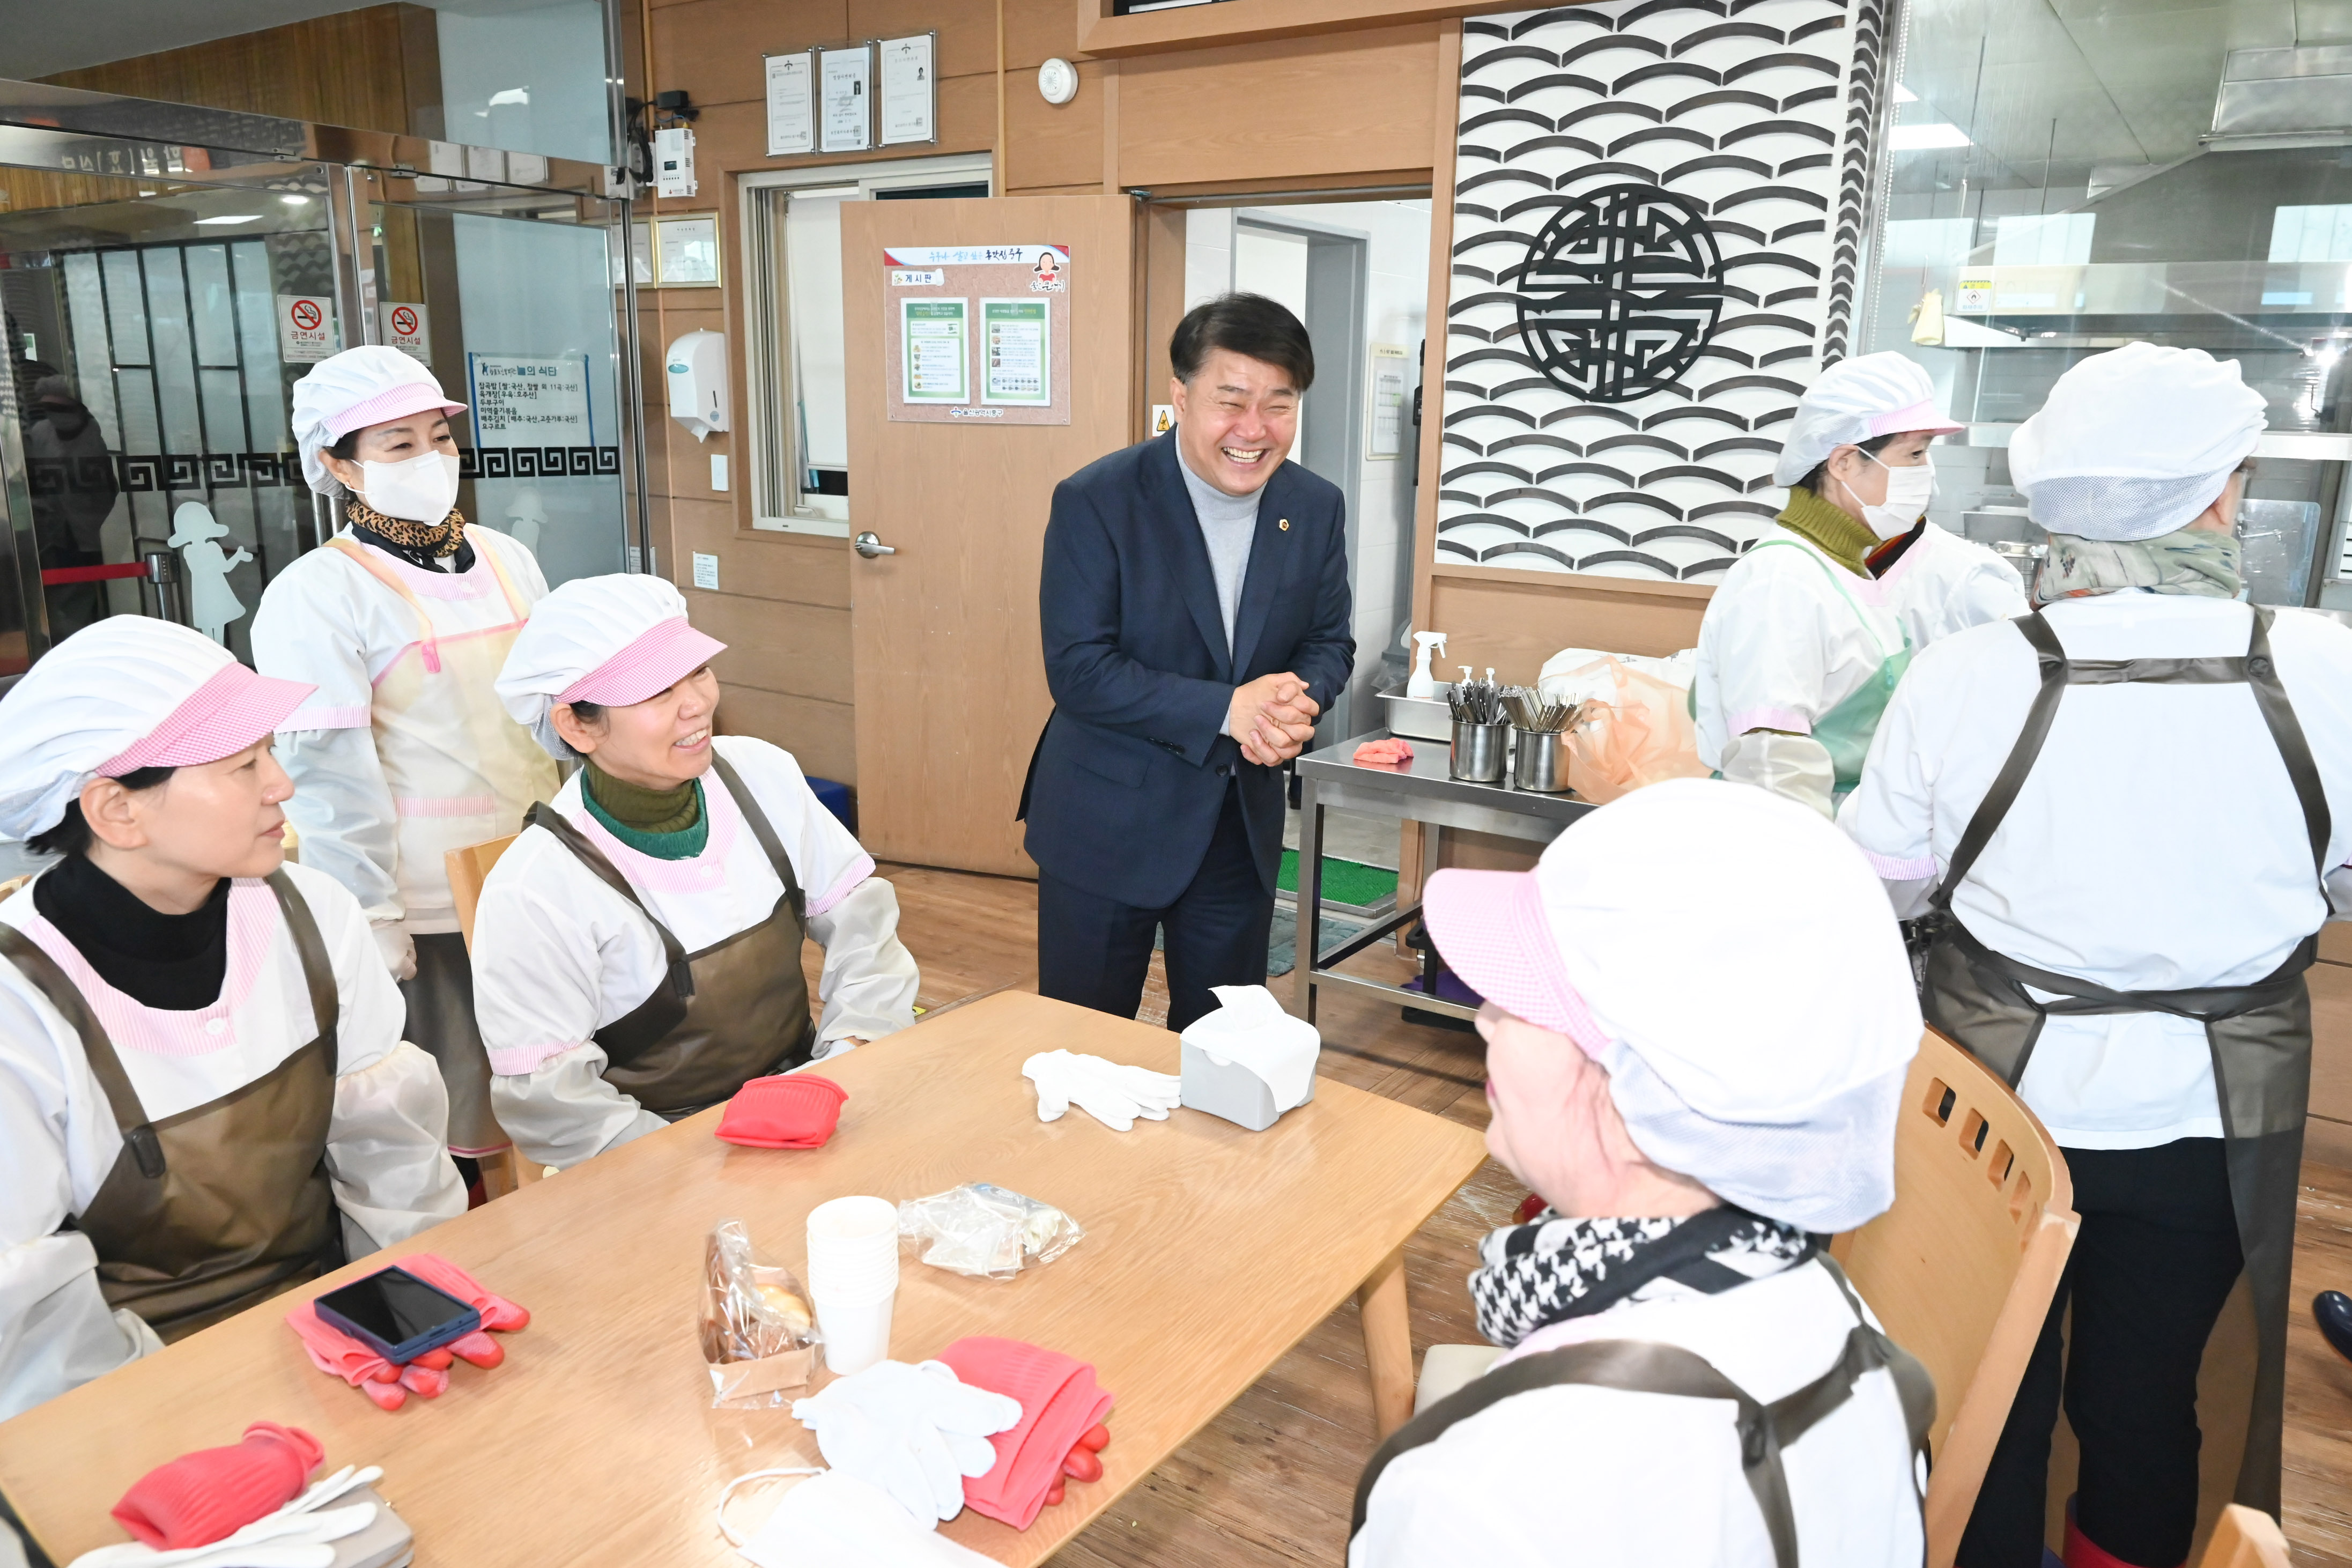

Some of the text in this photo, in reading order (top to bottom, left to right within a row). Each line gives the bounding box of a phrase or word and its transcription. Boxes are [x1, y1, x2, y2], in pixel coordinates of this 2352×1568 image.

[1008, 248, 1023, 262] 중구
[905, 274, 932, 283] 게시판
[291, 331, 326, 341] 금연시설
[391, 336, 421, 345] 금연시설
[538, 366, 557, 376] 식단
[480, 407, 517, 415] 미역줄기볶음
